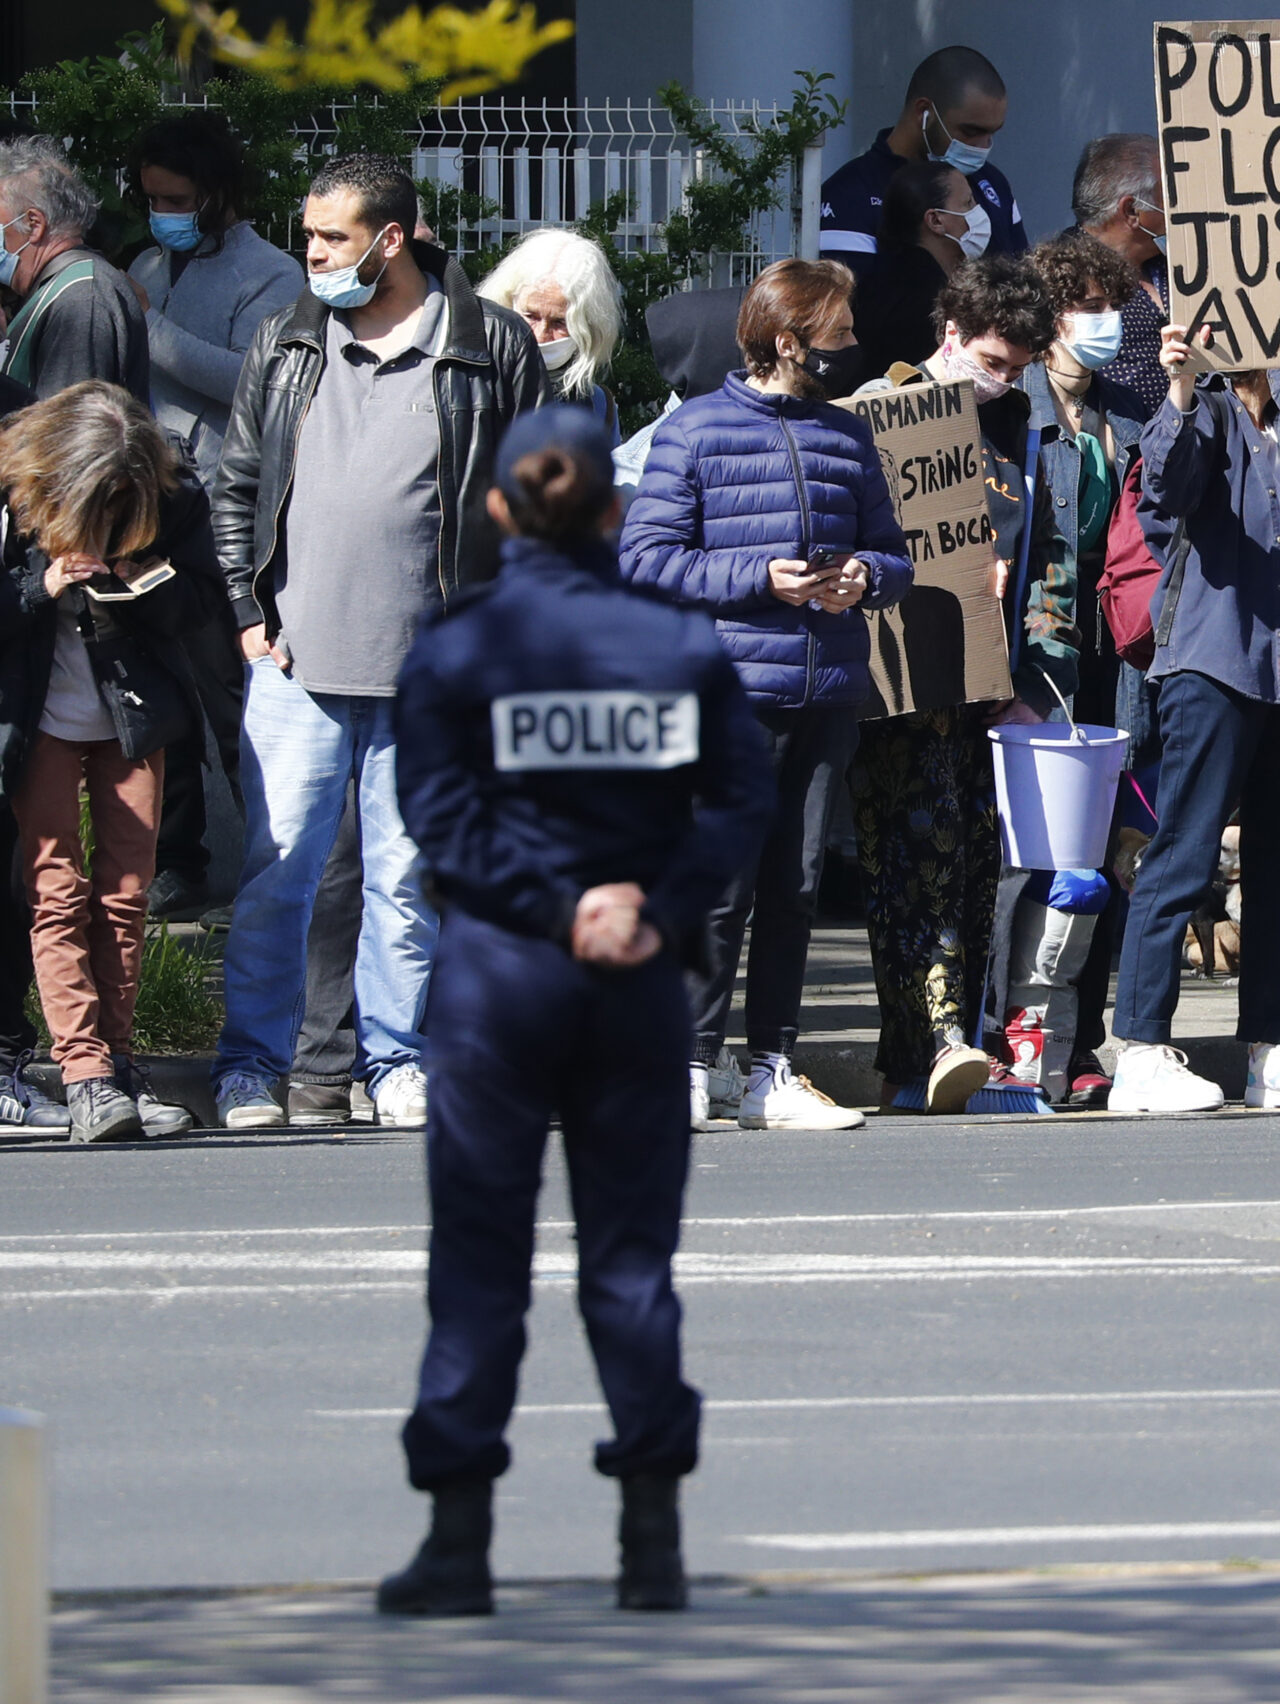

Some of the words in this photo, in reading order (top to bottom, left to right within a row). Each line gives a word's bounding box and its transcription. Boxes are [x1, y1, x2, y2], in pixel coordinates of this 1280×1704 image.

[855, 382, 962, 434] ARMANIN
[937, 513, 993, 555] BOCA
[511, 704, 677, 755] POLICE
